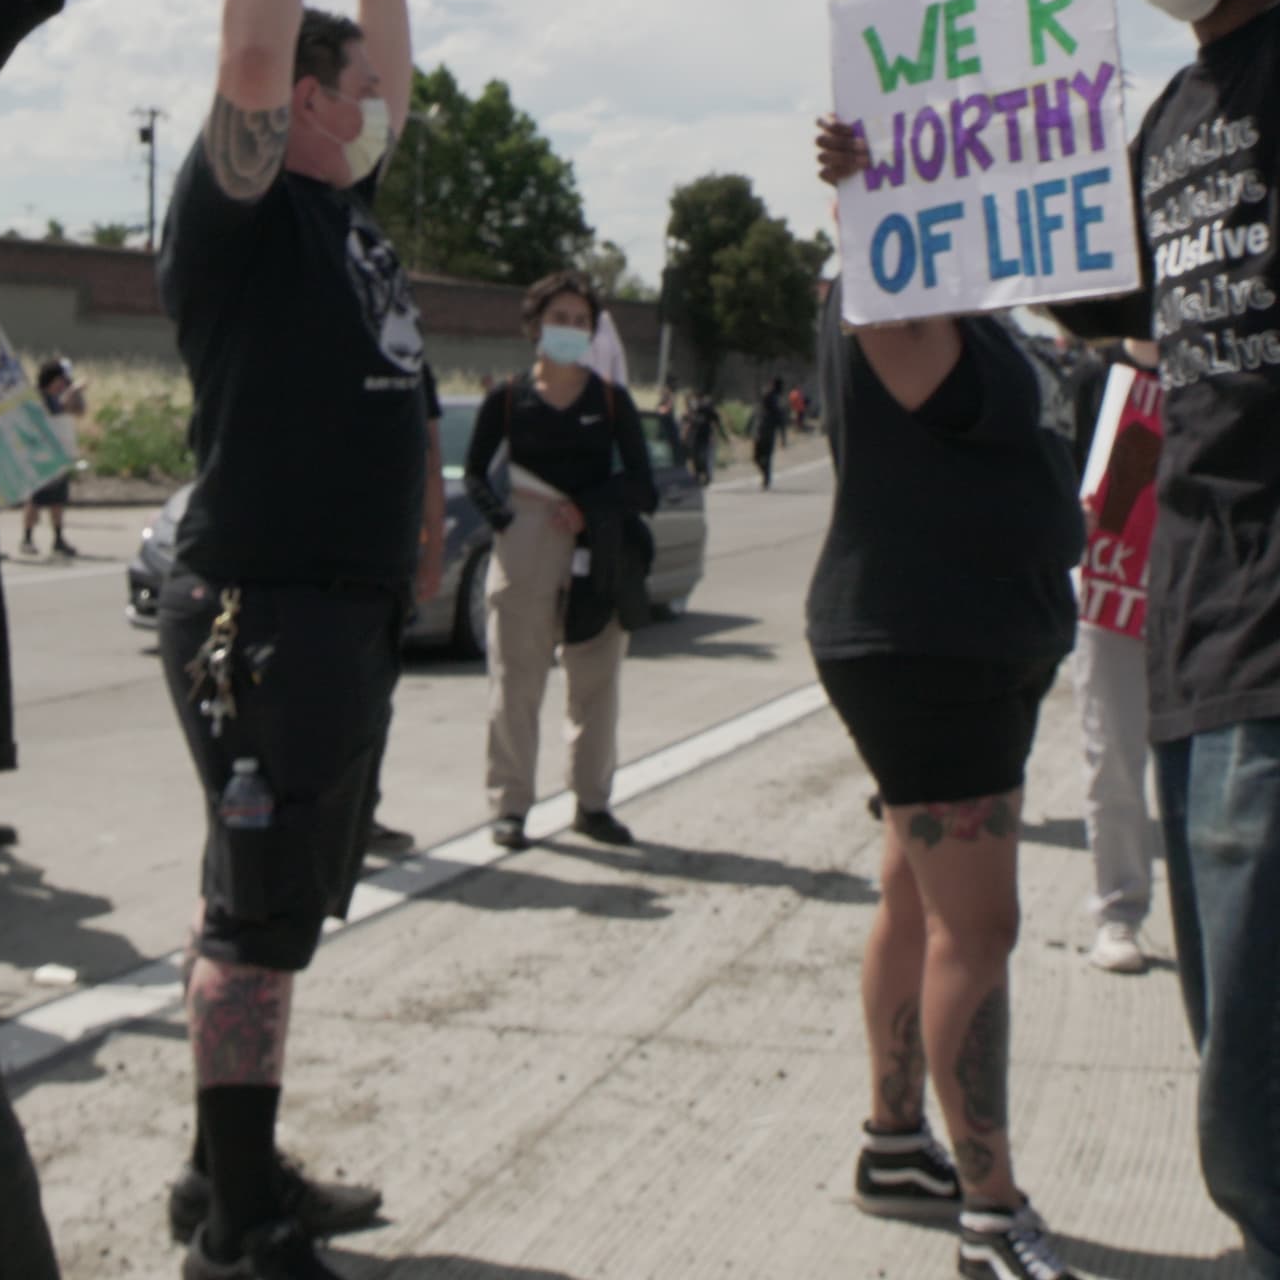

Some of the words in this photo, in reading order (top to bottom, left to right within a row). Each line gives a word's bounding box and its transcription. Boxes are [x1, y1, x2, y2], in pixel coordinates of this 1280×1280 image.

[853, 61, 1116, 192] WORTHY
[870, 201, 964, 295] OF
[983, 166, 1114, 280] LIFE
